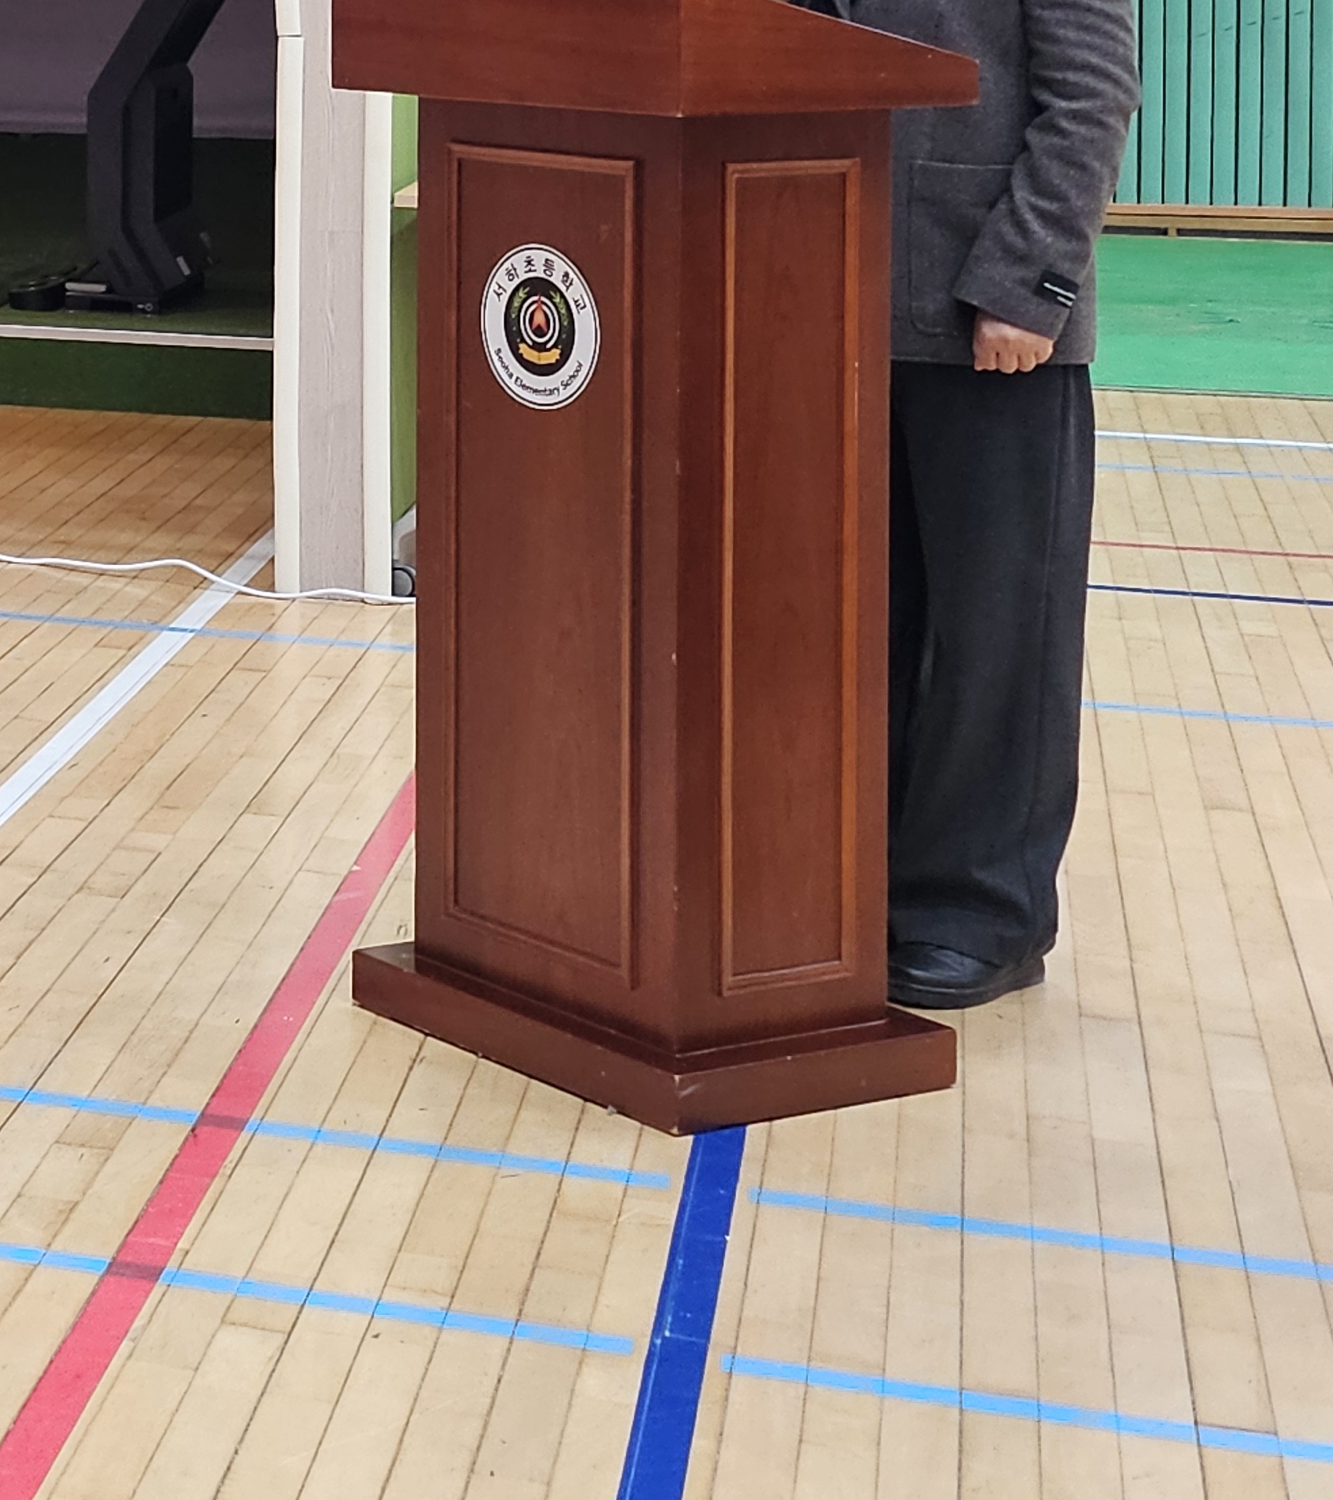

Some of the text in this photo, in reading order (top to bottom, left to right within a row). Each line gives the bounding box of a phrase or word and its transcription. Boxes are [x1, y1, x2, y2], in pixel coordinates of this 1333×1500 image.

[493, 255, 587, 315] 서하초등학교
[514, 376, 561, 397] Elementary
[560, 359, 583, 391] School
